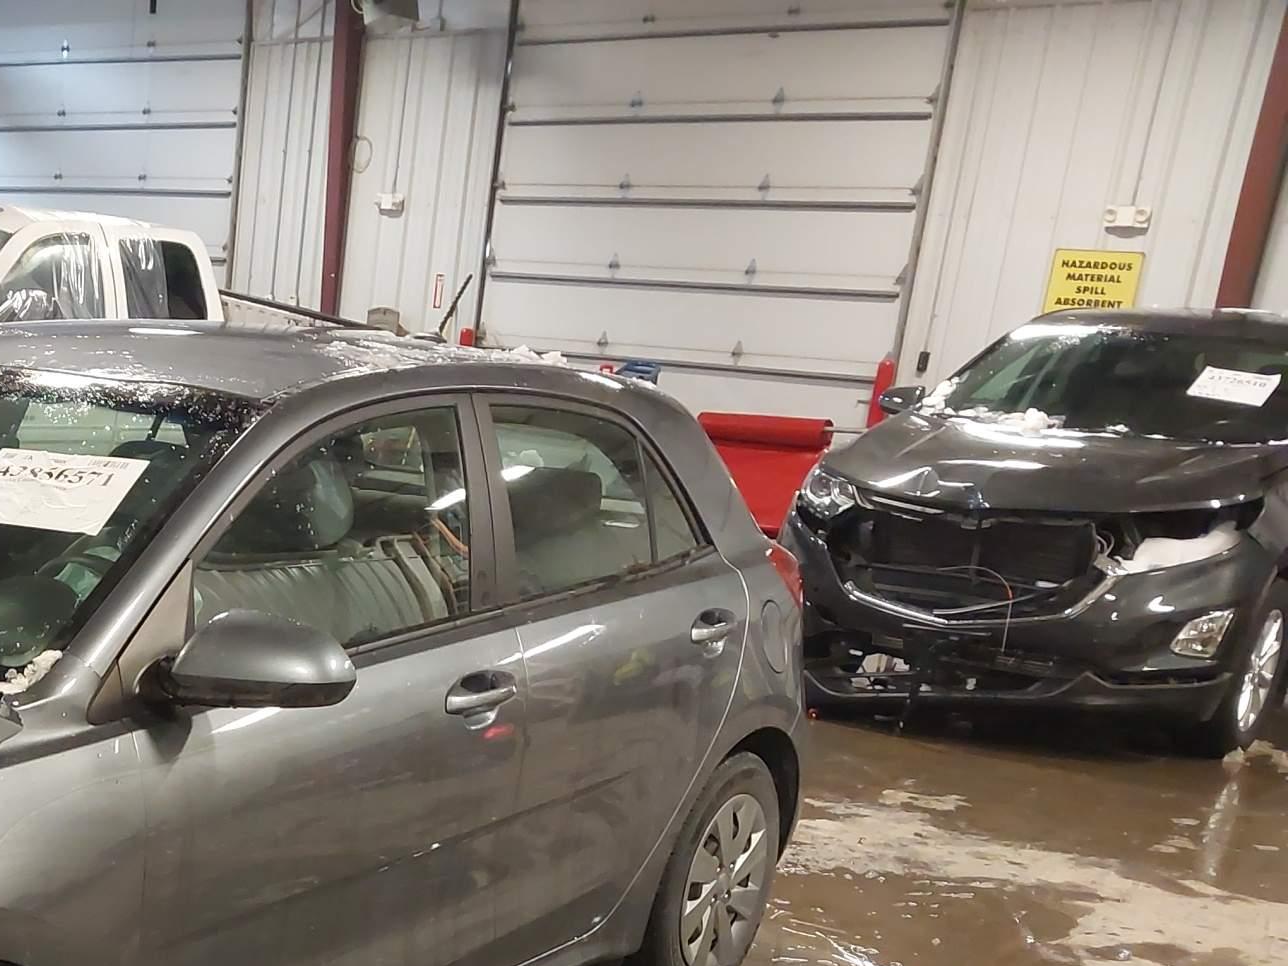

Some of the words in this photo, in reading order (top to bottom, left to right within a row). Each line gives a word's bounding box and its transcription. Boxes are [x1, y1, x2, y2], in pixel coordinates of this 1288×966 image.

[1061, 259, 1133, 271] HAZARDOUS
[1065, 273, 1122, 283] MATERIAL
[1074, 285, 1106, 296] SPILL
[1054, 297, 1123, 309] ABSORBENT
